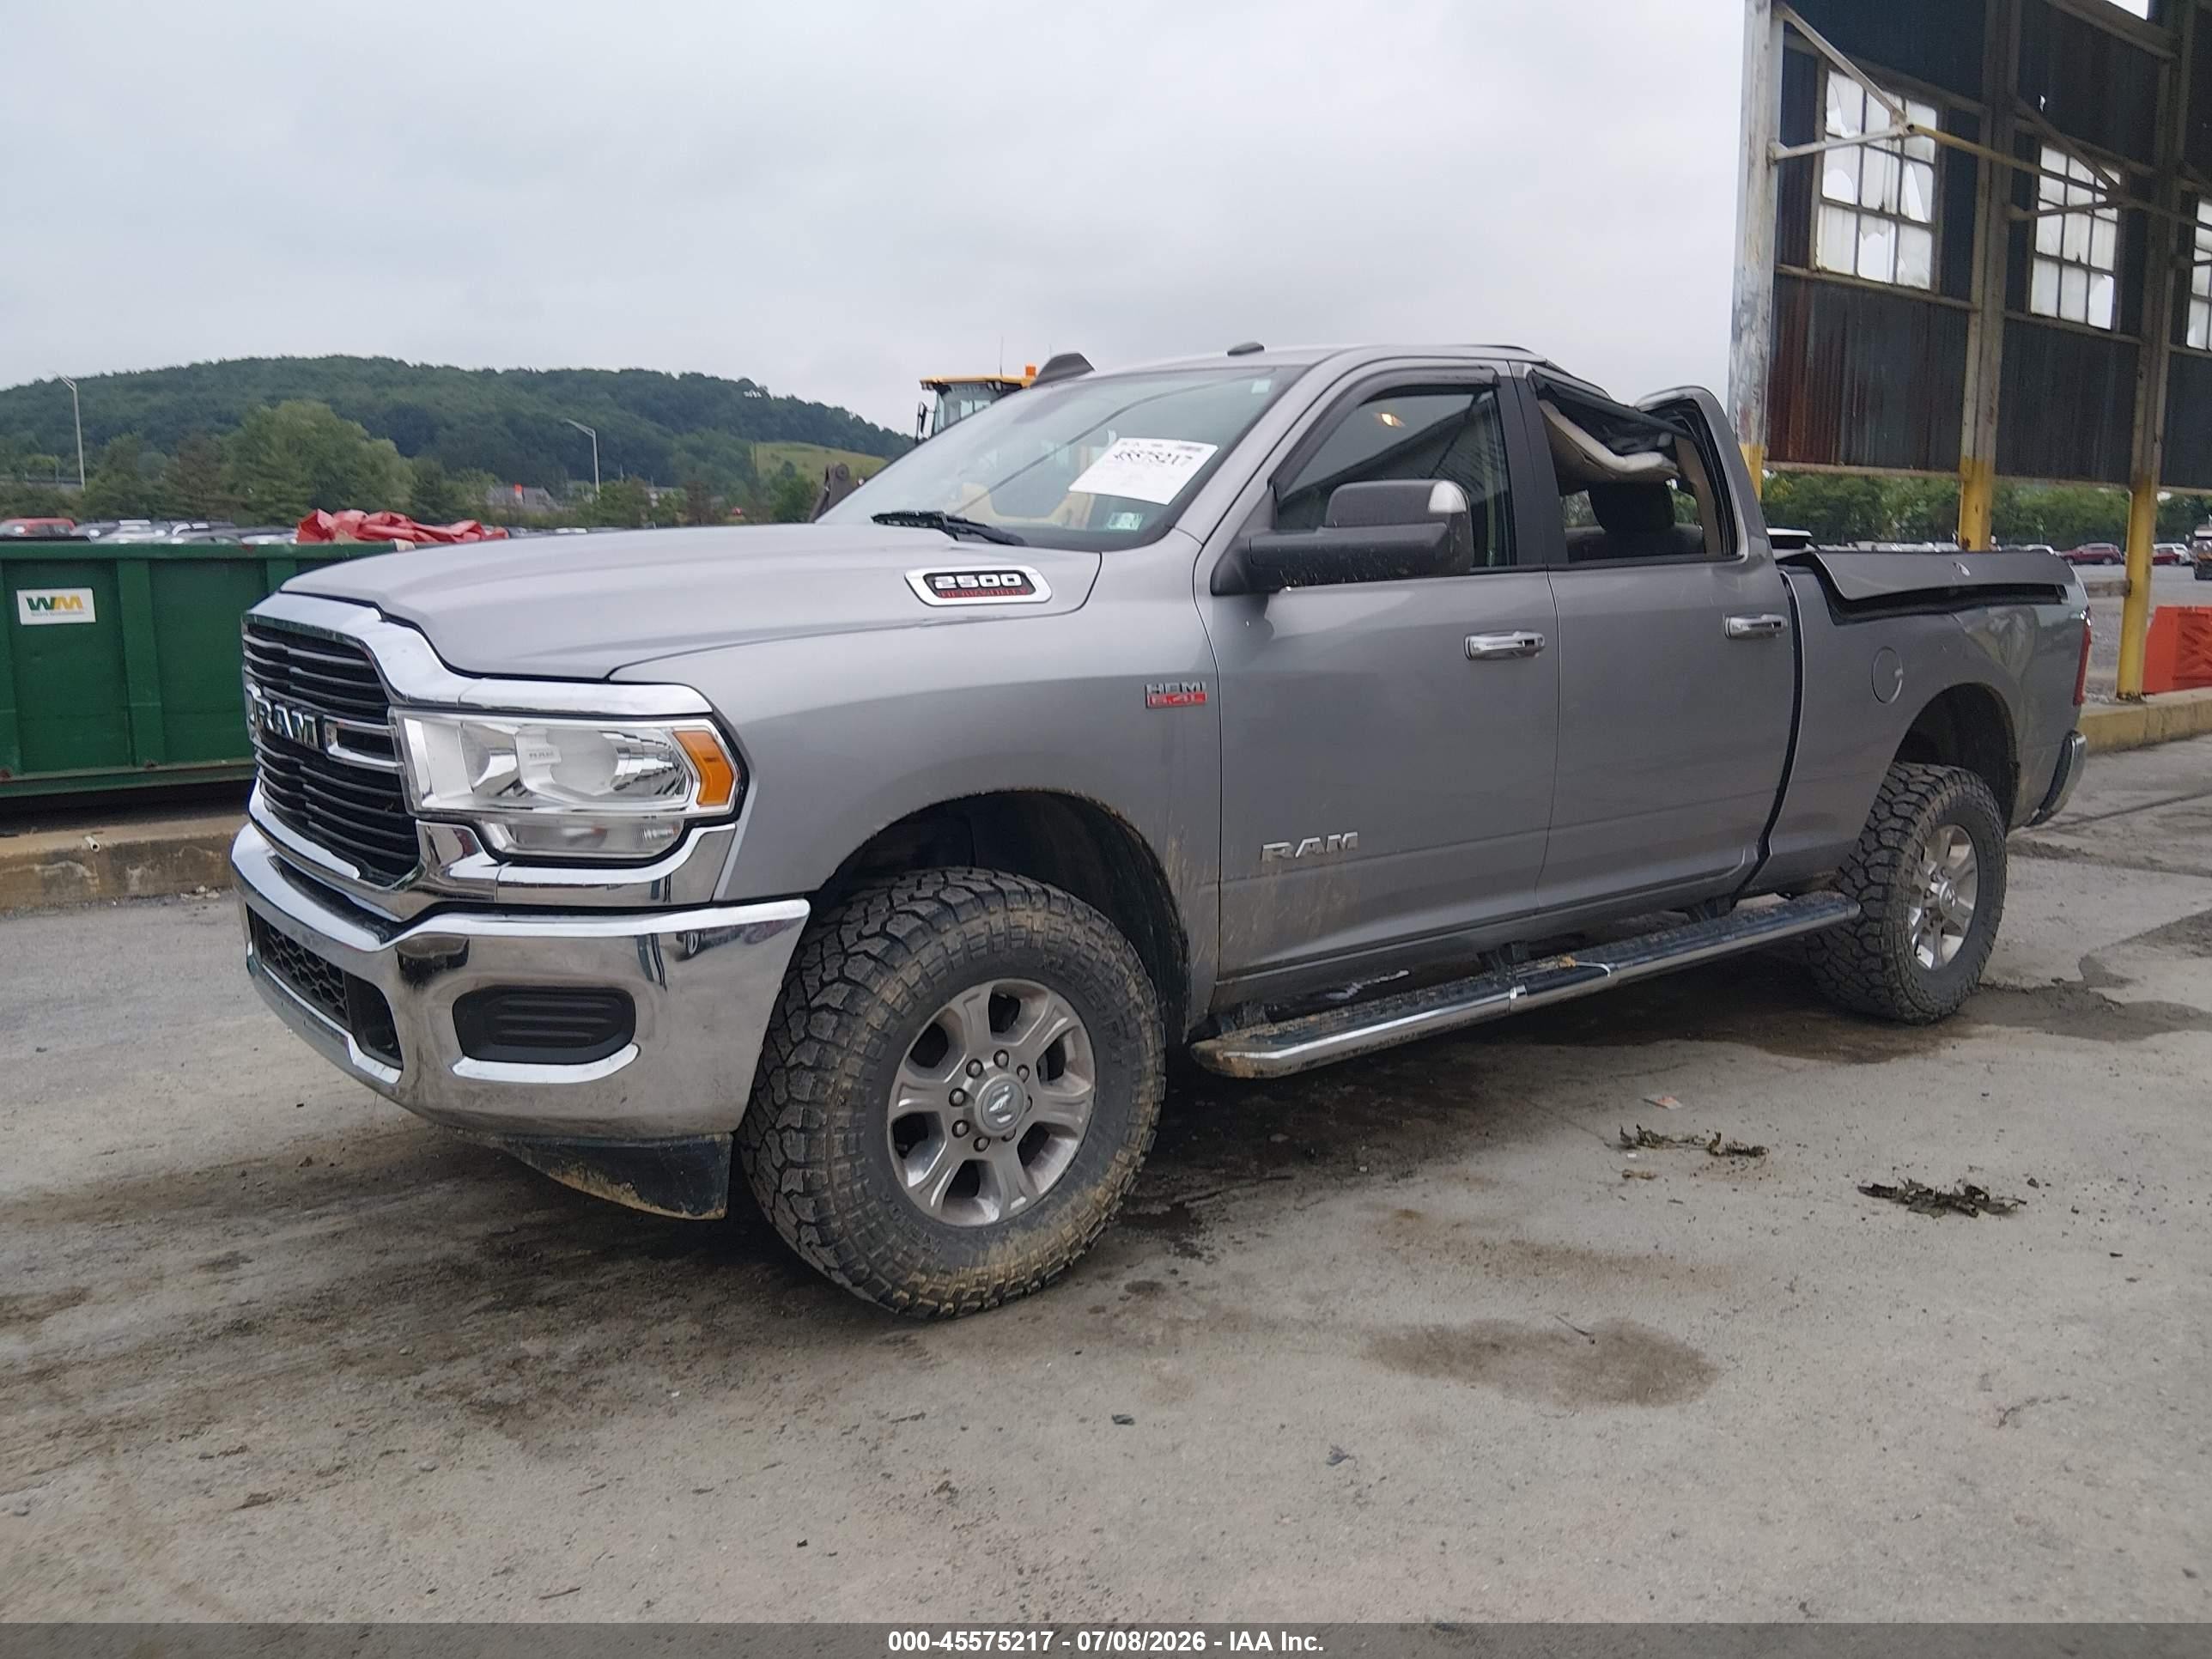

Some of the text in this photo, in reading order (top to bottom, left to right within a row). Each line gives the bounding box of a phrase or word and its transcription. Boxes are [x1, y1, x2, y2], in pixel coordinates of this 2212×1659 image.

[935, 574, 1022, 588] 2500
[26, 595, 83, 611] WM
[1146, 681, 1207, 694] HEMI
[255, 696, 319, 749] RAM
[1261, 831, 1358, 861] RAM
